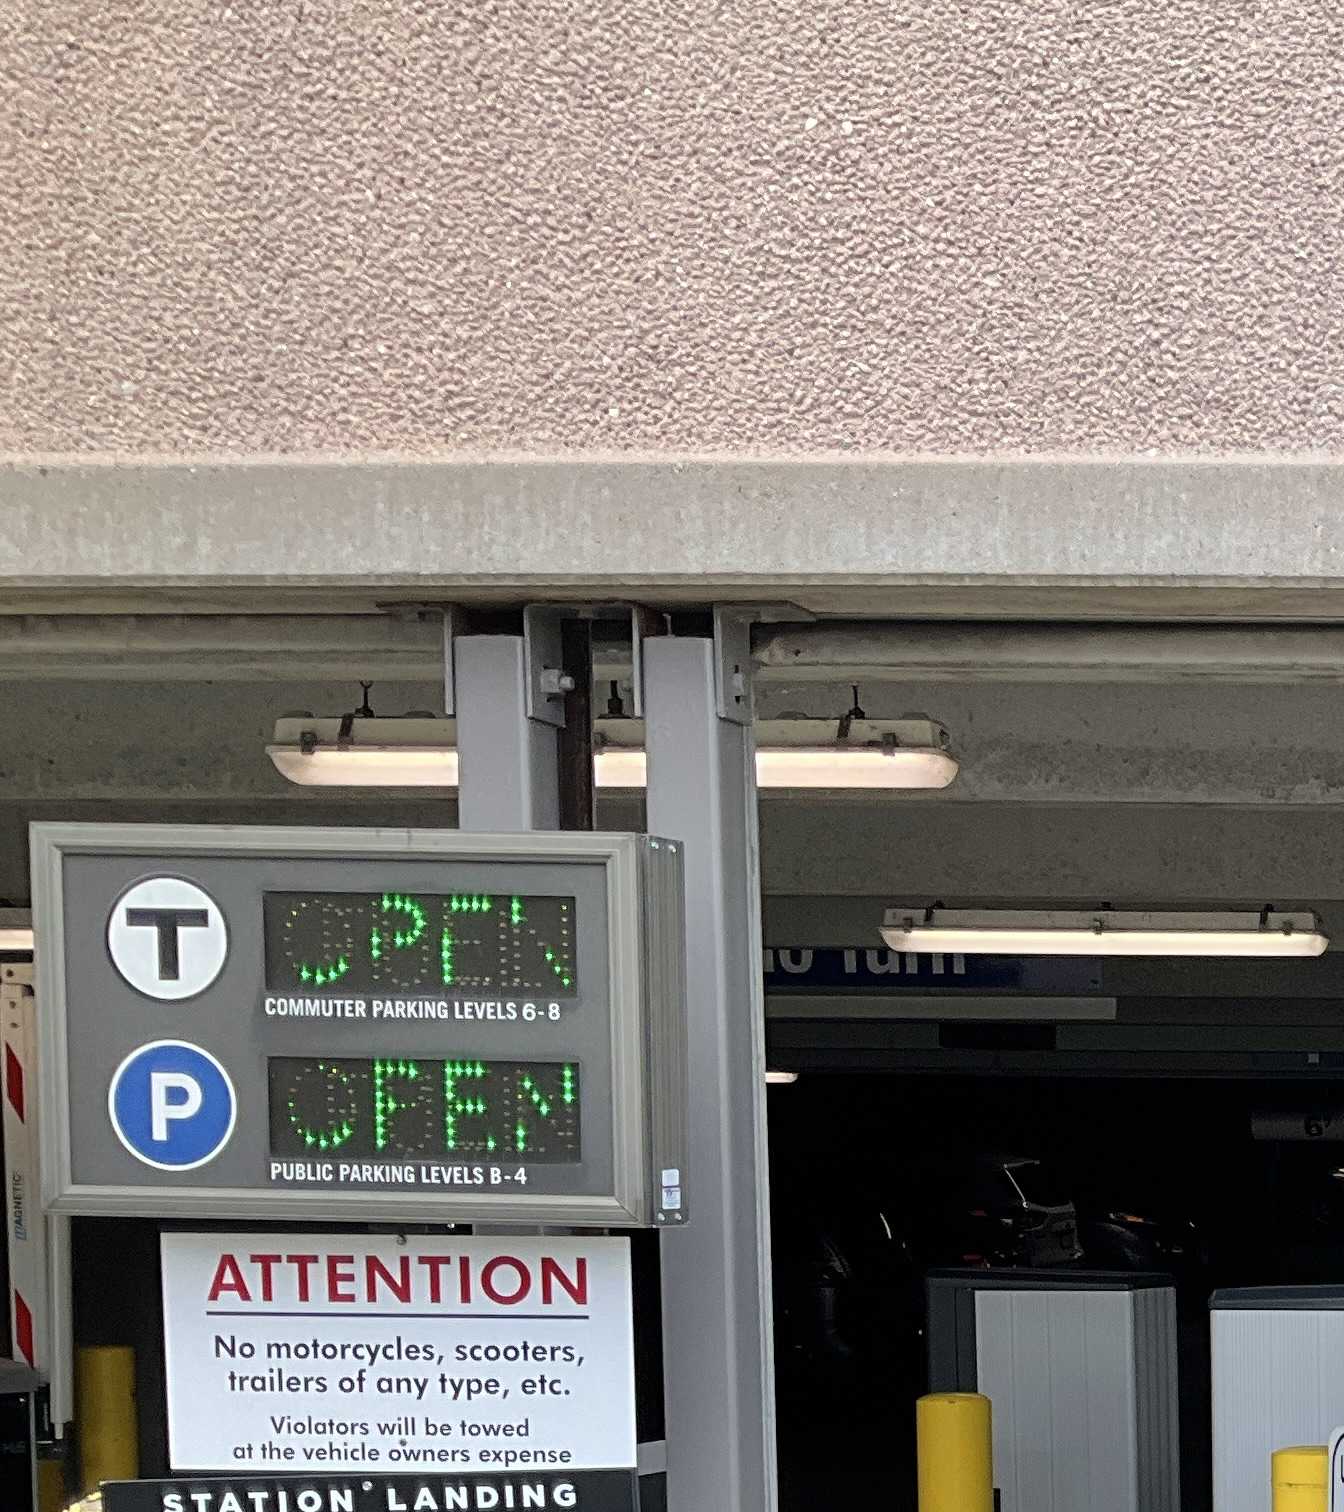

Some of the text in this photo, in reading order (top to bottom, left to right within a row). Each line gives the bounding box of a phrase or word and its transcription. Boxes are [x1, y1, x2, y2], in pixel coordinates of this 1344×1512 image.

[125, 907, 209, 980] T
[265, 998, 366, 1017] COMMUTER
[373, 1000, 448, 1018] PARKING
[455, 1002, 517, 1020] LEVELS
[151, 1072, 202, 1140] P
[271, 1163, 527, 1184] PUBLIC PARKING LEVELS B-4
[208, 1254, 587, 1305] ATTENTION
[215, 1335, 584, 1366] No motorcycles, scooters,
[229, 1368, 569, 1400] trailers of any type, etc.
[271, 1416, 528, 1436] Violators will be towed
[232, 1441, 571, 1467] at the vehicle owners expense
[388, 1484, 576, 1511] LANDING
